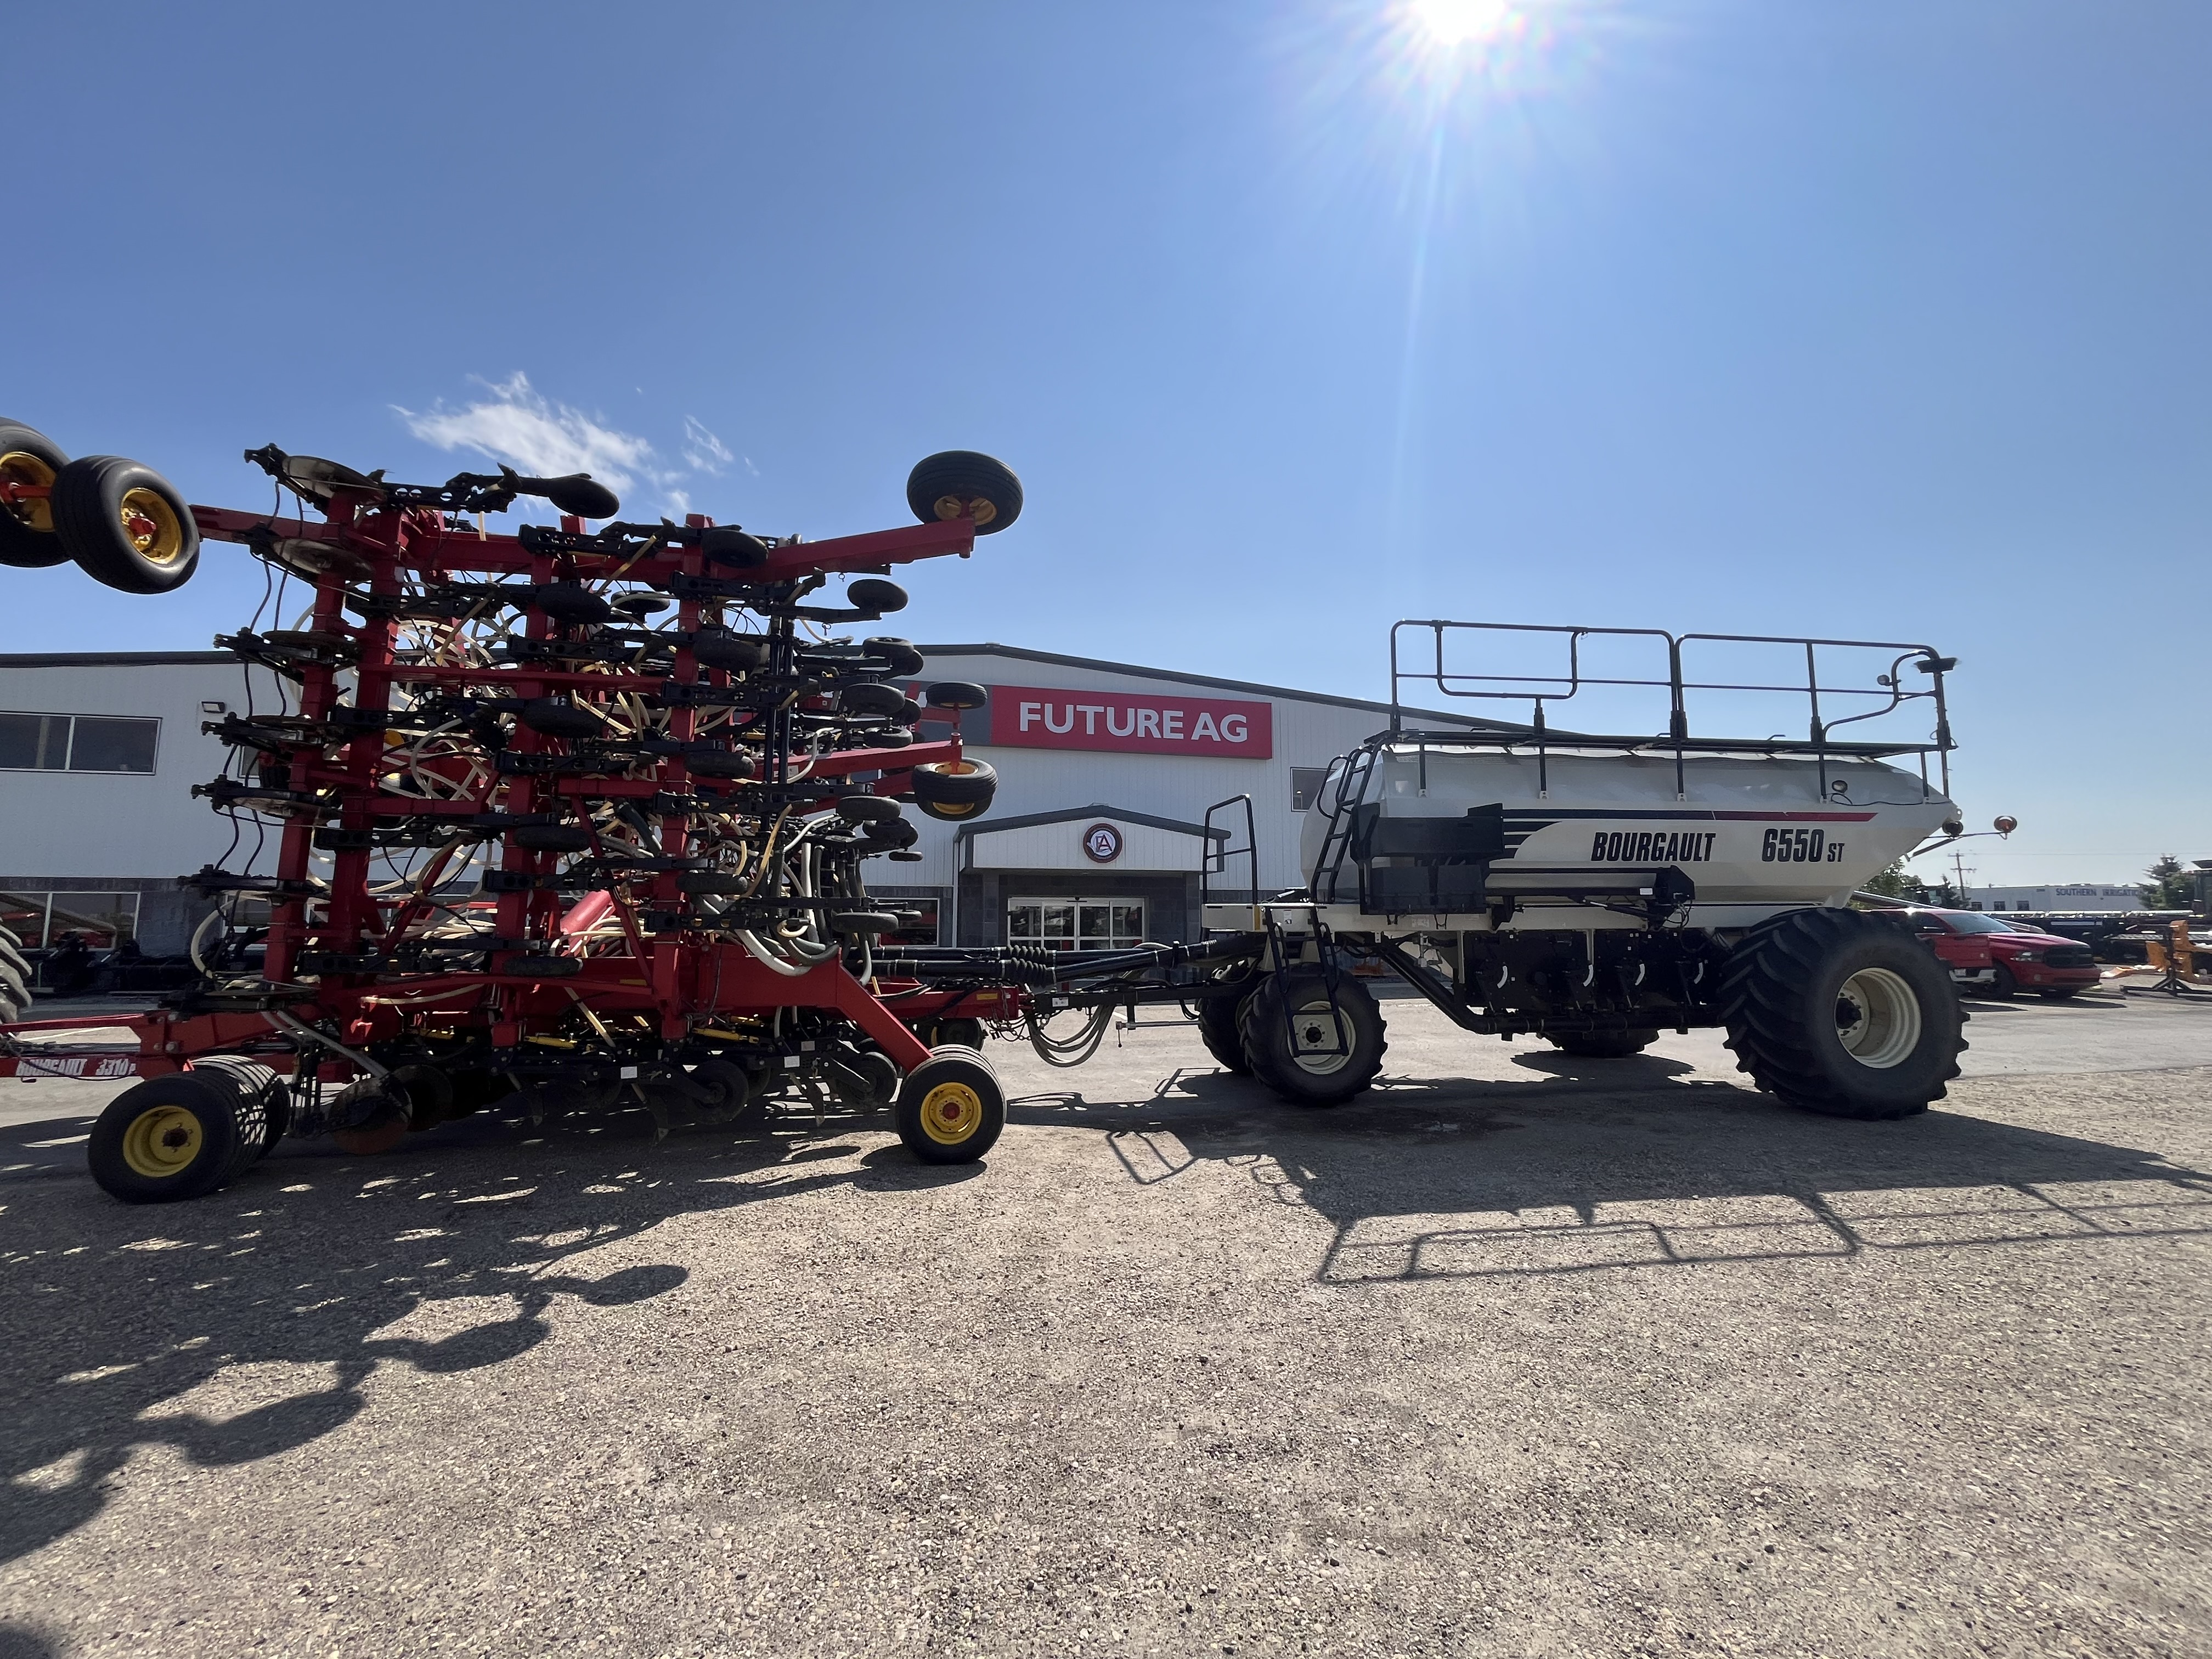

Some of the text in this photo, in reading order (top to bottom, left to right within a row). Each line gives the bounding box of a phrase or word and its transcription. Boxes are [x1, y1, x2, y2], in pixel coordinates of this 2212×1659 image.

[1019, 701, 1248, 743] FUTURE AG
[1590, 828, 1845, 862] BOURGAULT 6550 ST
[2056, 888, 2097, 896] SOUTHERN
